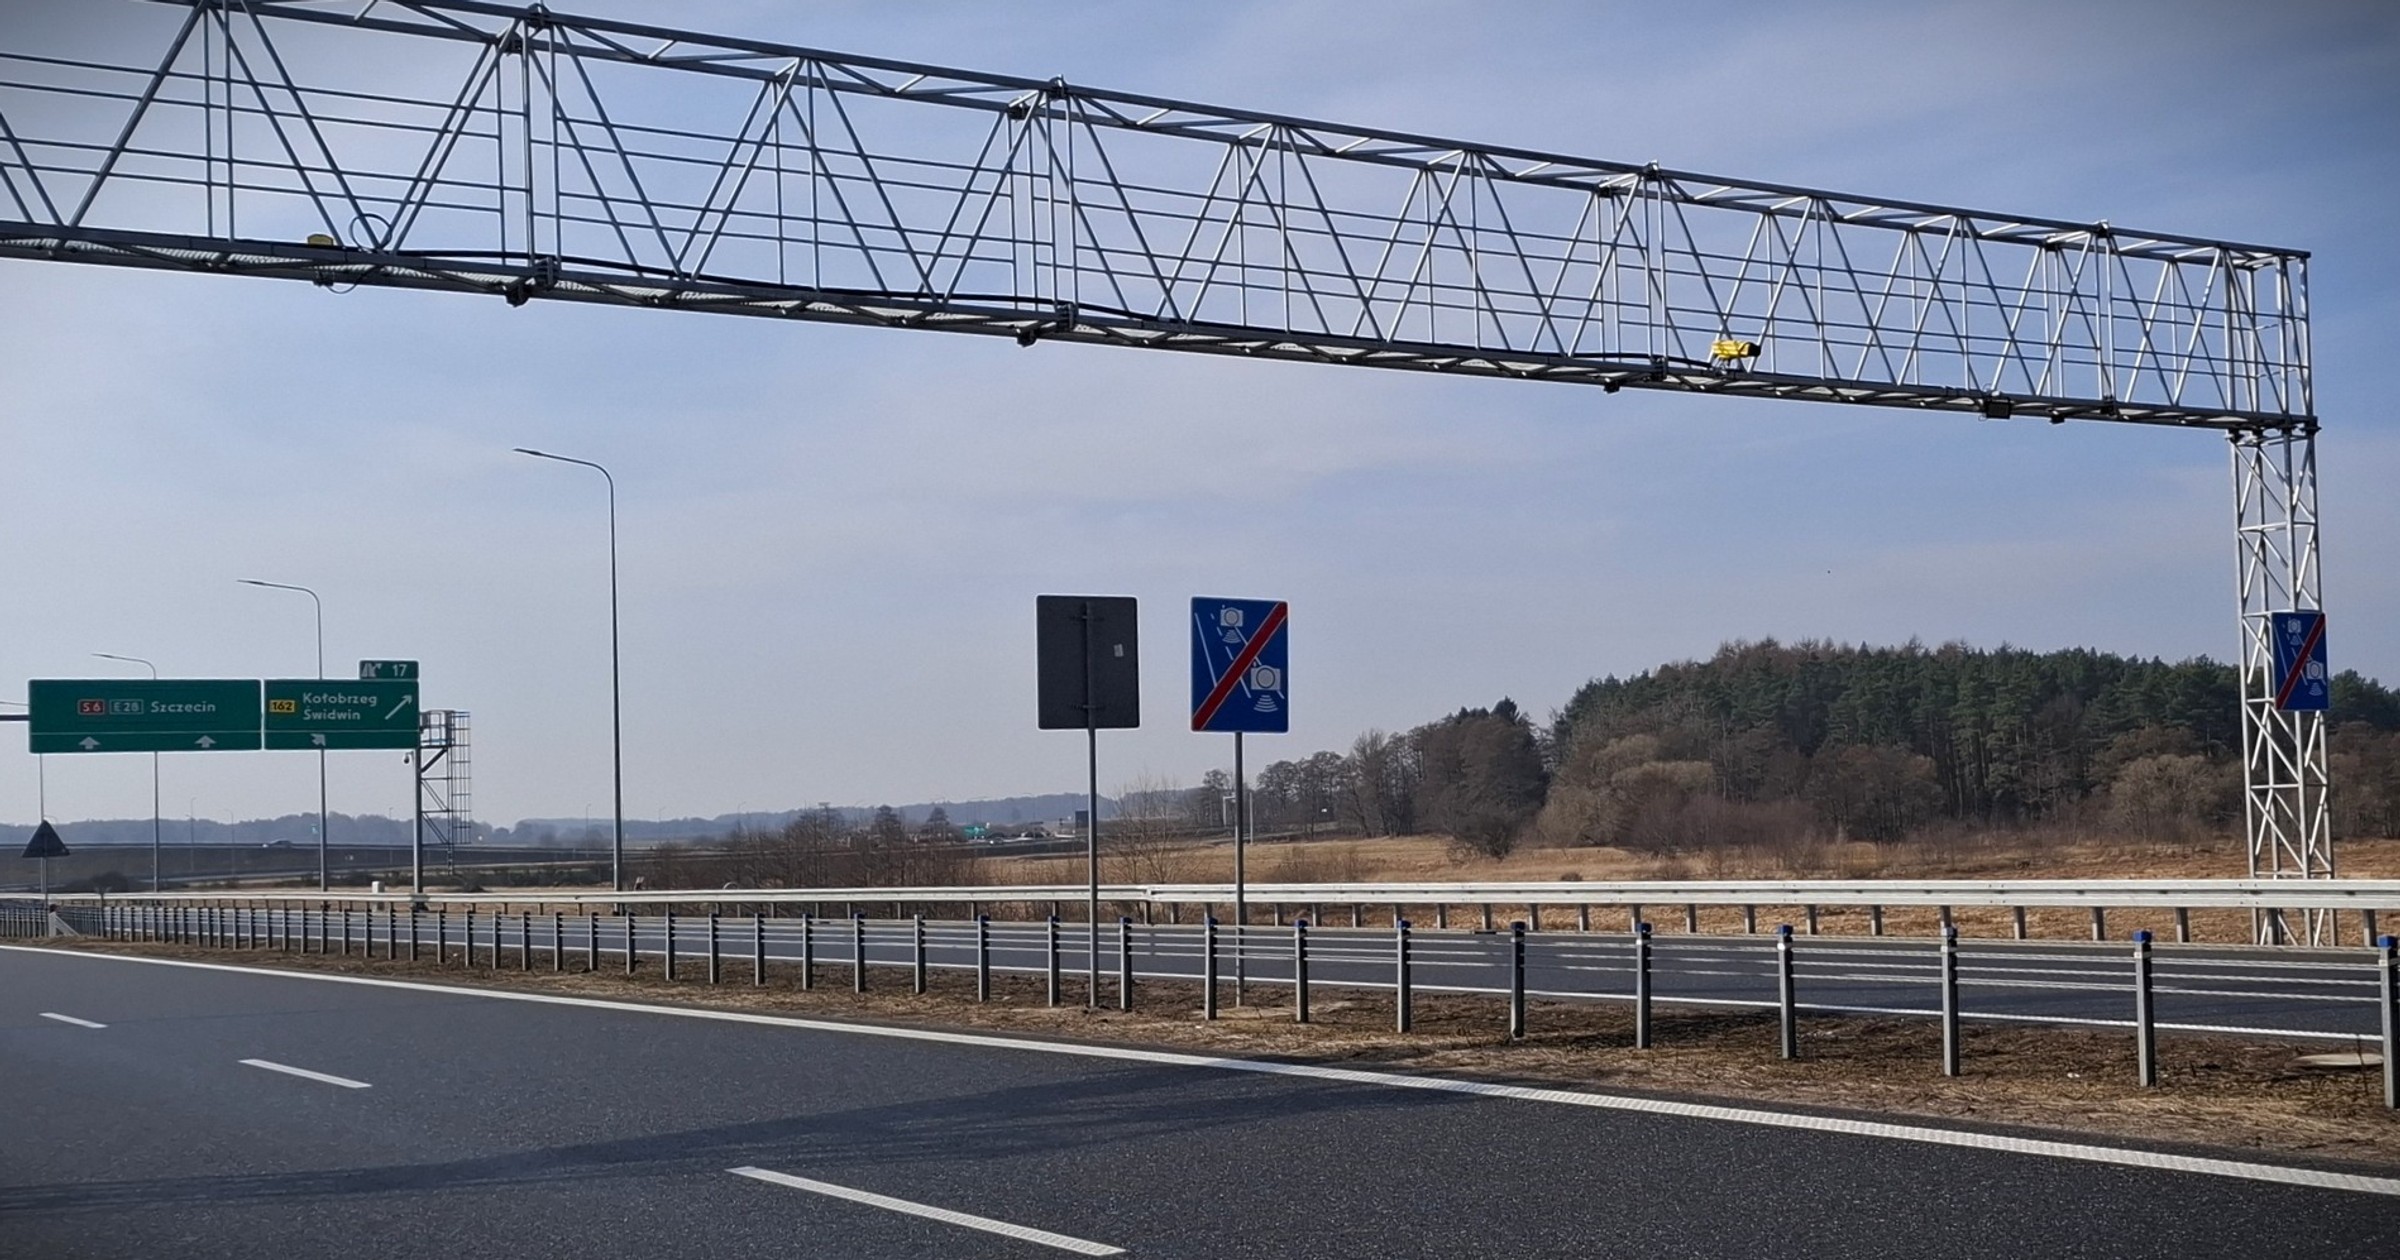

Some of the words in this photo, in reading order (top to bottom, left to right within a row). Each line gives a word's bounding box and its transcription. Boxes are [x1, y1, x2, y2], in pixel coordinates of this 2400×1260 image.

[393, 664, 407, 677] 17
[303, 692, 377, 706] Kołobrzeg
[151, 701, 216, 713] Szczecin
[271, 702, 293, 711] 162
[303, 705, 360, 720] Świdwin
